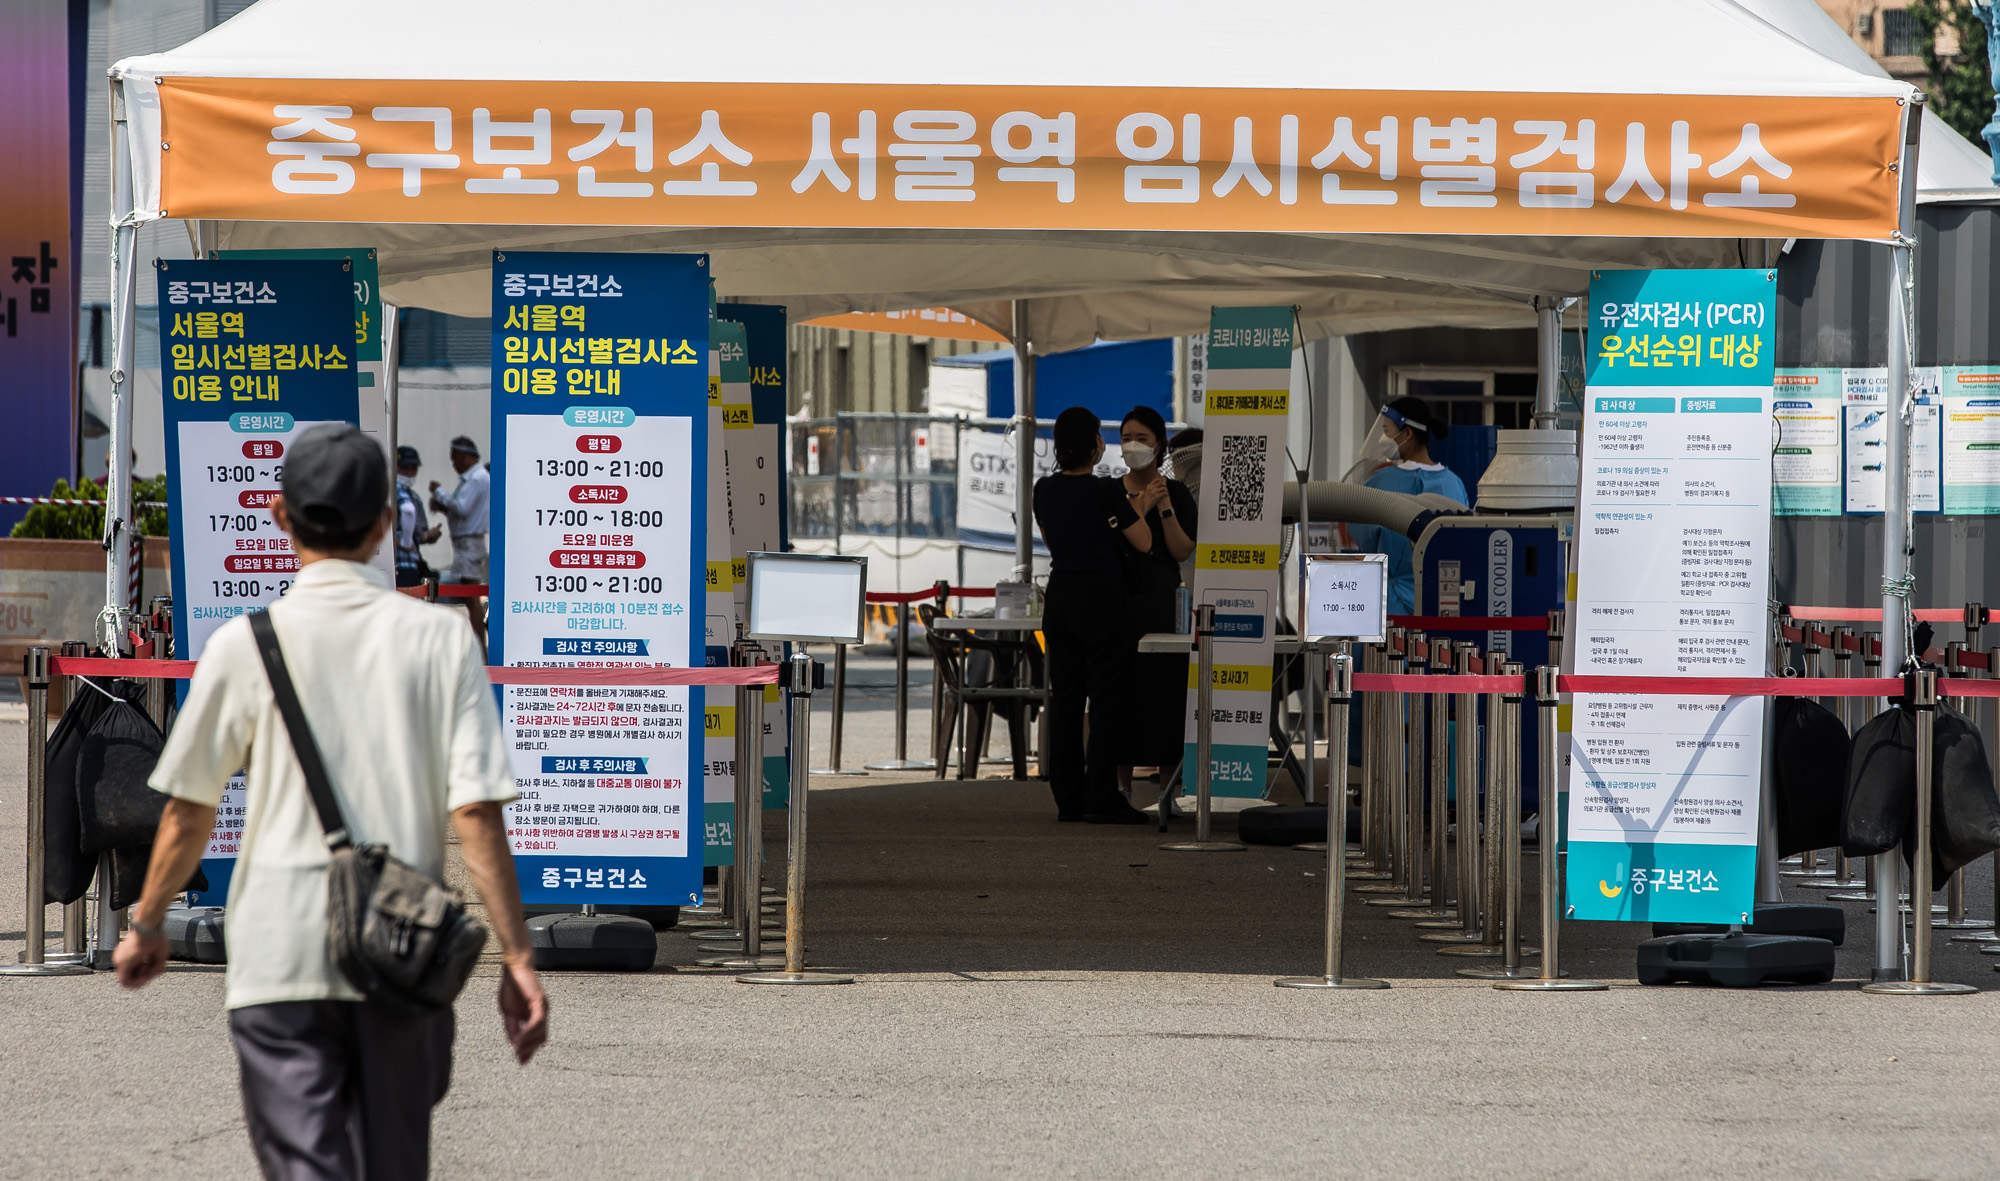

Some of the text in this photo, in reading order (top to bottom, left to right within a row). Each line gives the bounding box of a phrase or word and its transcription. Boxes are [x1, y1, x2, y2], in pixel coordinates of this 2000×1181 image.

[266, 105, 1797, 211] 중구보건소 서울역 임시선별검사소
[168, 281, 277, 304] 중구보건소
[503, 274, 623, 297] 중구보건소
[504, 305, 585, 332] 서울역
[1600, 301, 1765, 328] 유전자검사 (PCR)
[170, 312, 244, 339] 서울역
[1212, 327, 1290, 347] 코로나19 검사 접수
[171, 344, 348, 370] 임시선별검사소
[503, 337, 698, 365] 임시선별검사소
[719, 342, 743, 361] 접수
[1599, 334, 1701, 367] 우선순위
[1710, 334, 1762, 368] 대상
[173, 375, 279, 401] 이용 안내
[503, 368, 620, 395] 이용 안내
[1601, 400, 1636, 410] 검사대상
[1687, 400, 1716, 410] 증빙자료
[239, 416, 284, 429] 운영시간
[574, 410, 625, 424] 운영시간
[731, 410, 748, 423] 스캔
[253, 444, 274, 456] 평일
[588, 438, 611, 450] 평일
[207, 466, 255, 482] 13:00
[536, 459, 663, 477] 13:00 21:00
[578, 489, 619, 500] 소독시간
[210, 515, 257, 532] 17:00
[536, 510, 663, 528] 17:00 18:00
[235, 539, 266, 551] 토요일
[563, 535, 634, 547] 토요일 미운영
[234, 558, 302, 570] 일요일 및 공휴일
[560, 554, 636, 566] 일요일 및 공휴일
[1219, 550, 1251, 564] 전자문진표
[1252, 550, 1266, 564] 작성
[1493, 538, 1508, 597] COOLER
[212, 580, 260, 597] 13:00
[535, 576, 662, 593] 13:00 21:00
[1331, 581, 1357, 590] 소독시간
[511, 601, 684, 616] 검사시간을 고려하여 10분전 접수
[1348, 604, 1364, 612] 18:00
[568, 618, 627, 630] 마감합니다.
[556, 641, 637, 653] 검사 전 주의사항
[1220, 670, 1249, 685] 검사대기
[516, 687, 668, 698] 문진표에 연락처를 올바르게 기재해주세요.
[516, 702, 684, 713] 검사결과는 24~72시간 후에 문자 전송됩니다.
[516, 716, 682, 727] 검사결과지는 발급되지 않으며, 검사결과지
[1235, 709, 1263, 724] 문자 통보
[516, 729, 682, 739] 발급이 필요한 경우 병원에서 개별검사 하시기
[515, 742, 549, 750] 바랍니다.
[555, 759, 636, 772] 검사 후 주의사항
[713, 761, 728, 776] 문자
[533, 779, 541, 787] 후
[542, 779, 560, 788] 버스,
[562, 779, 585, 788] 지하철
[587, 779, 595, 788] 등
[597, 778, 632, 789] 대중교통
[635, 779, 661, 789] 이용이
[663, 779, 682, 789] 불가
[515, 804, 680, 814] 검사 후 바로 자택으로 귀가하여야 하며, 다른
[515, 816, 600, 825] 장소 방문이 금지됩니다.
[525, 829, 540, 838] 사항
[542, 829, 574, 838] 위반하여
[576, 830, 600, 838] 감염병
[602, 830, 618, 838] 발생
[620, 830, 628, 838] 시
[630, 830, 653, 839] 구상권
[515, 841, 558, 850] 수 있습니다.
[542, 868, 647, 889] 중구보건소
[1631, 868, 1719, 894] 중구보건소
